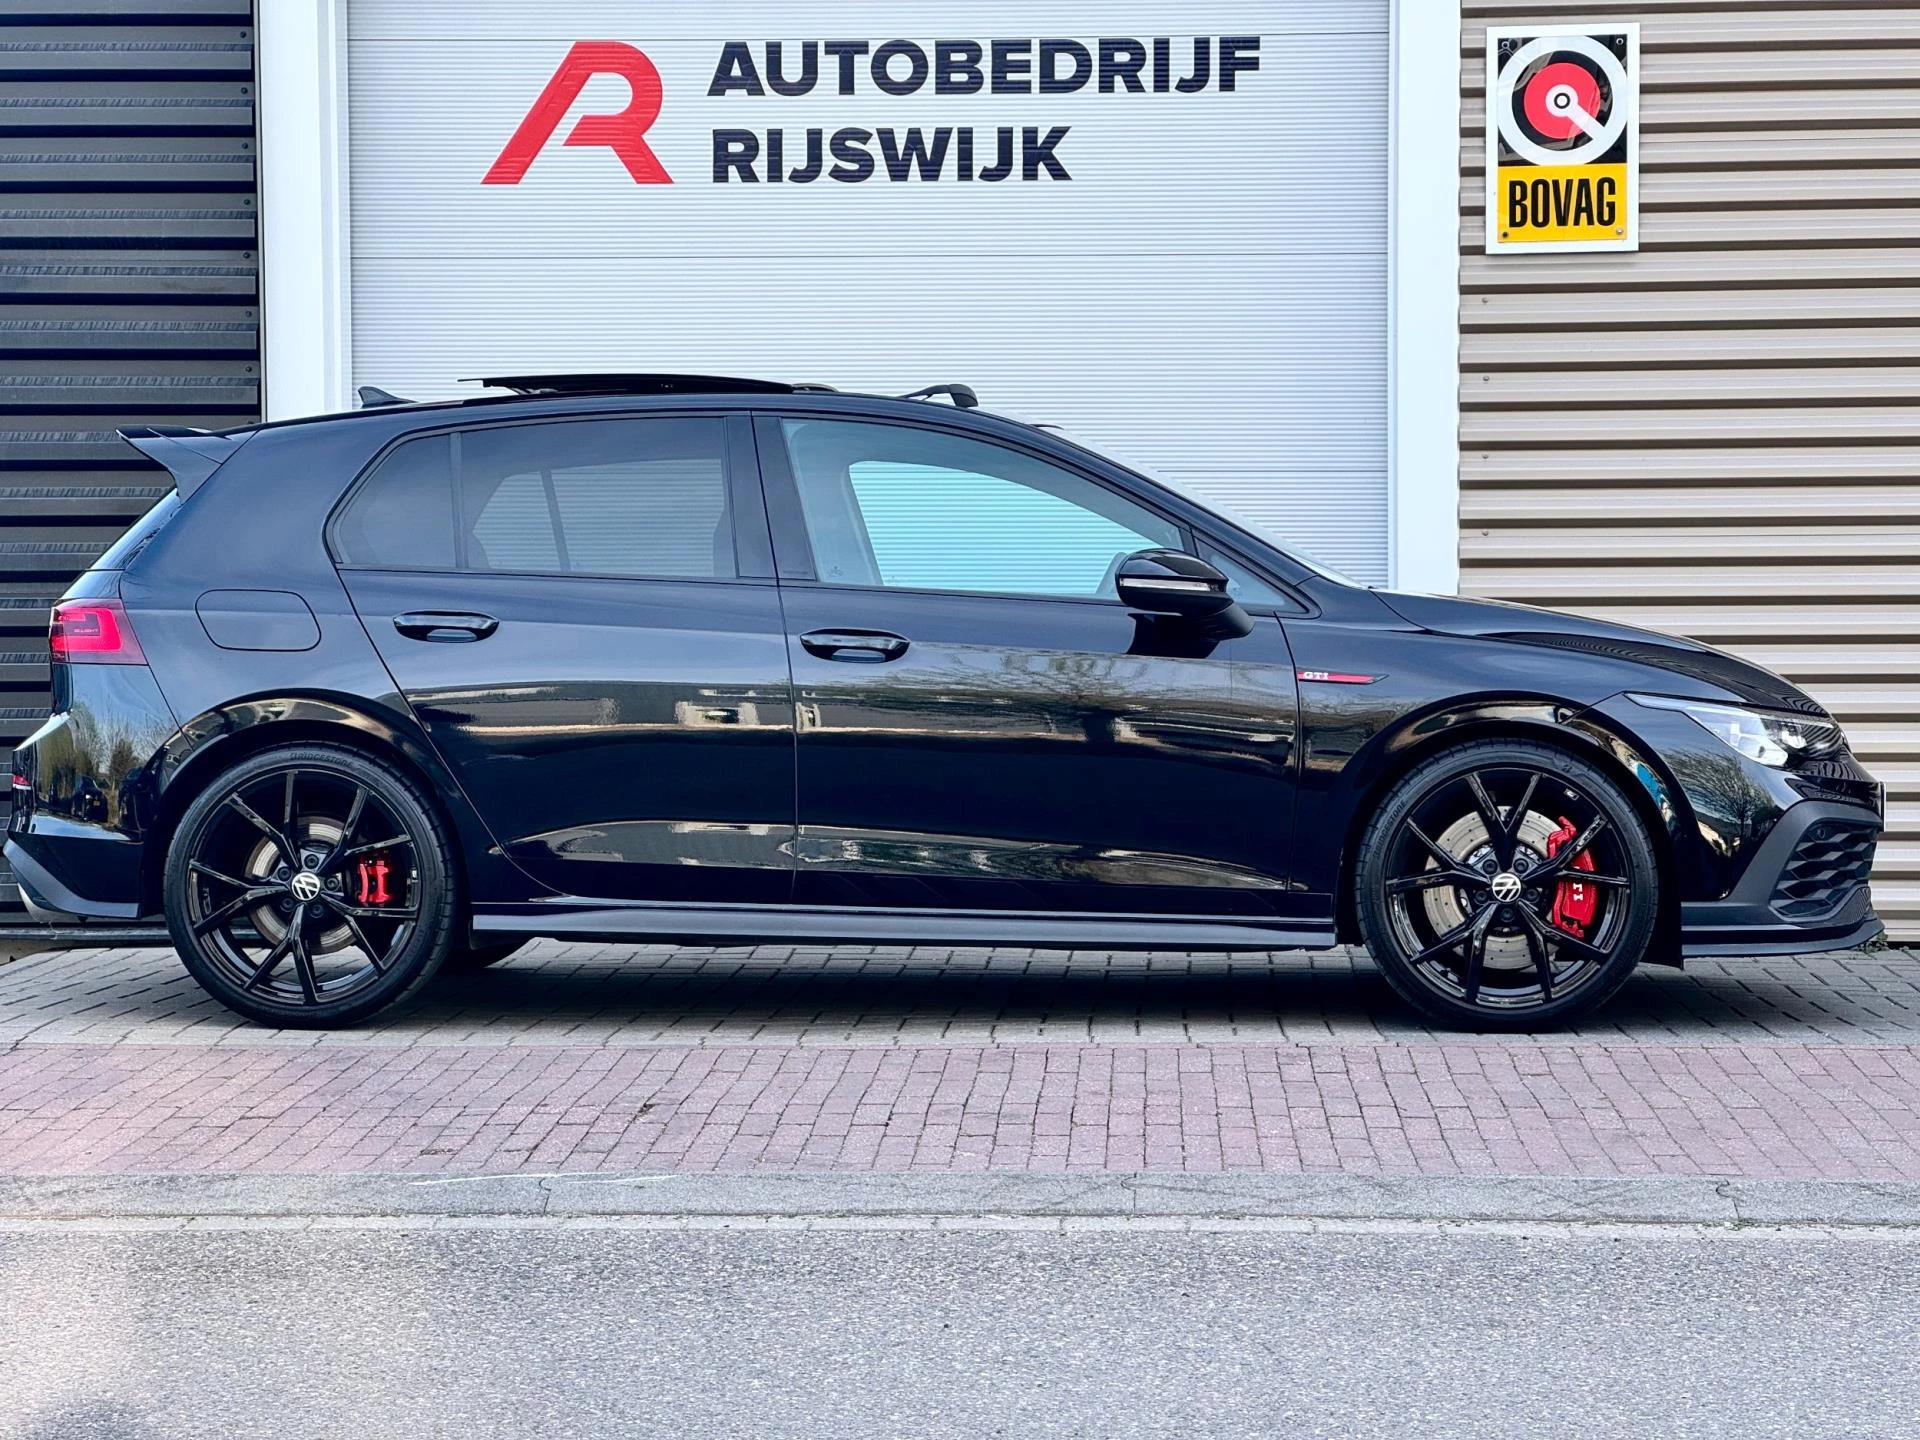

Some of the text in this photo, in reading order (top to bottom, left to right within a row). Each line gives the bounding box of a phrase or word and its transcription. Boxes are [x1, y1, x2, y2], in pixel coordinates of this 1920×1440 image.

[707, 36, 1261, 96] AUTOBEDRIJF
[712, 126, 1073, 182] RIJSWIJK
[1509, 177, 1616, 227] BOVAG
[1303, 671, 1329, 680] GTI
